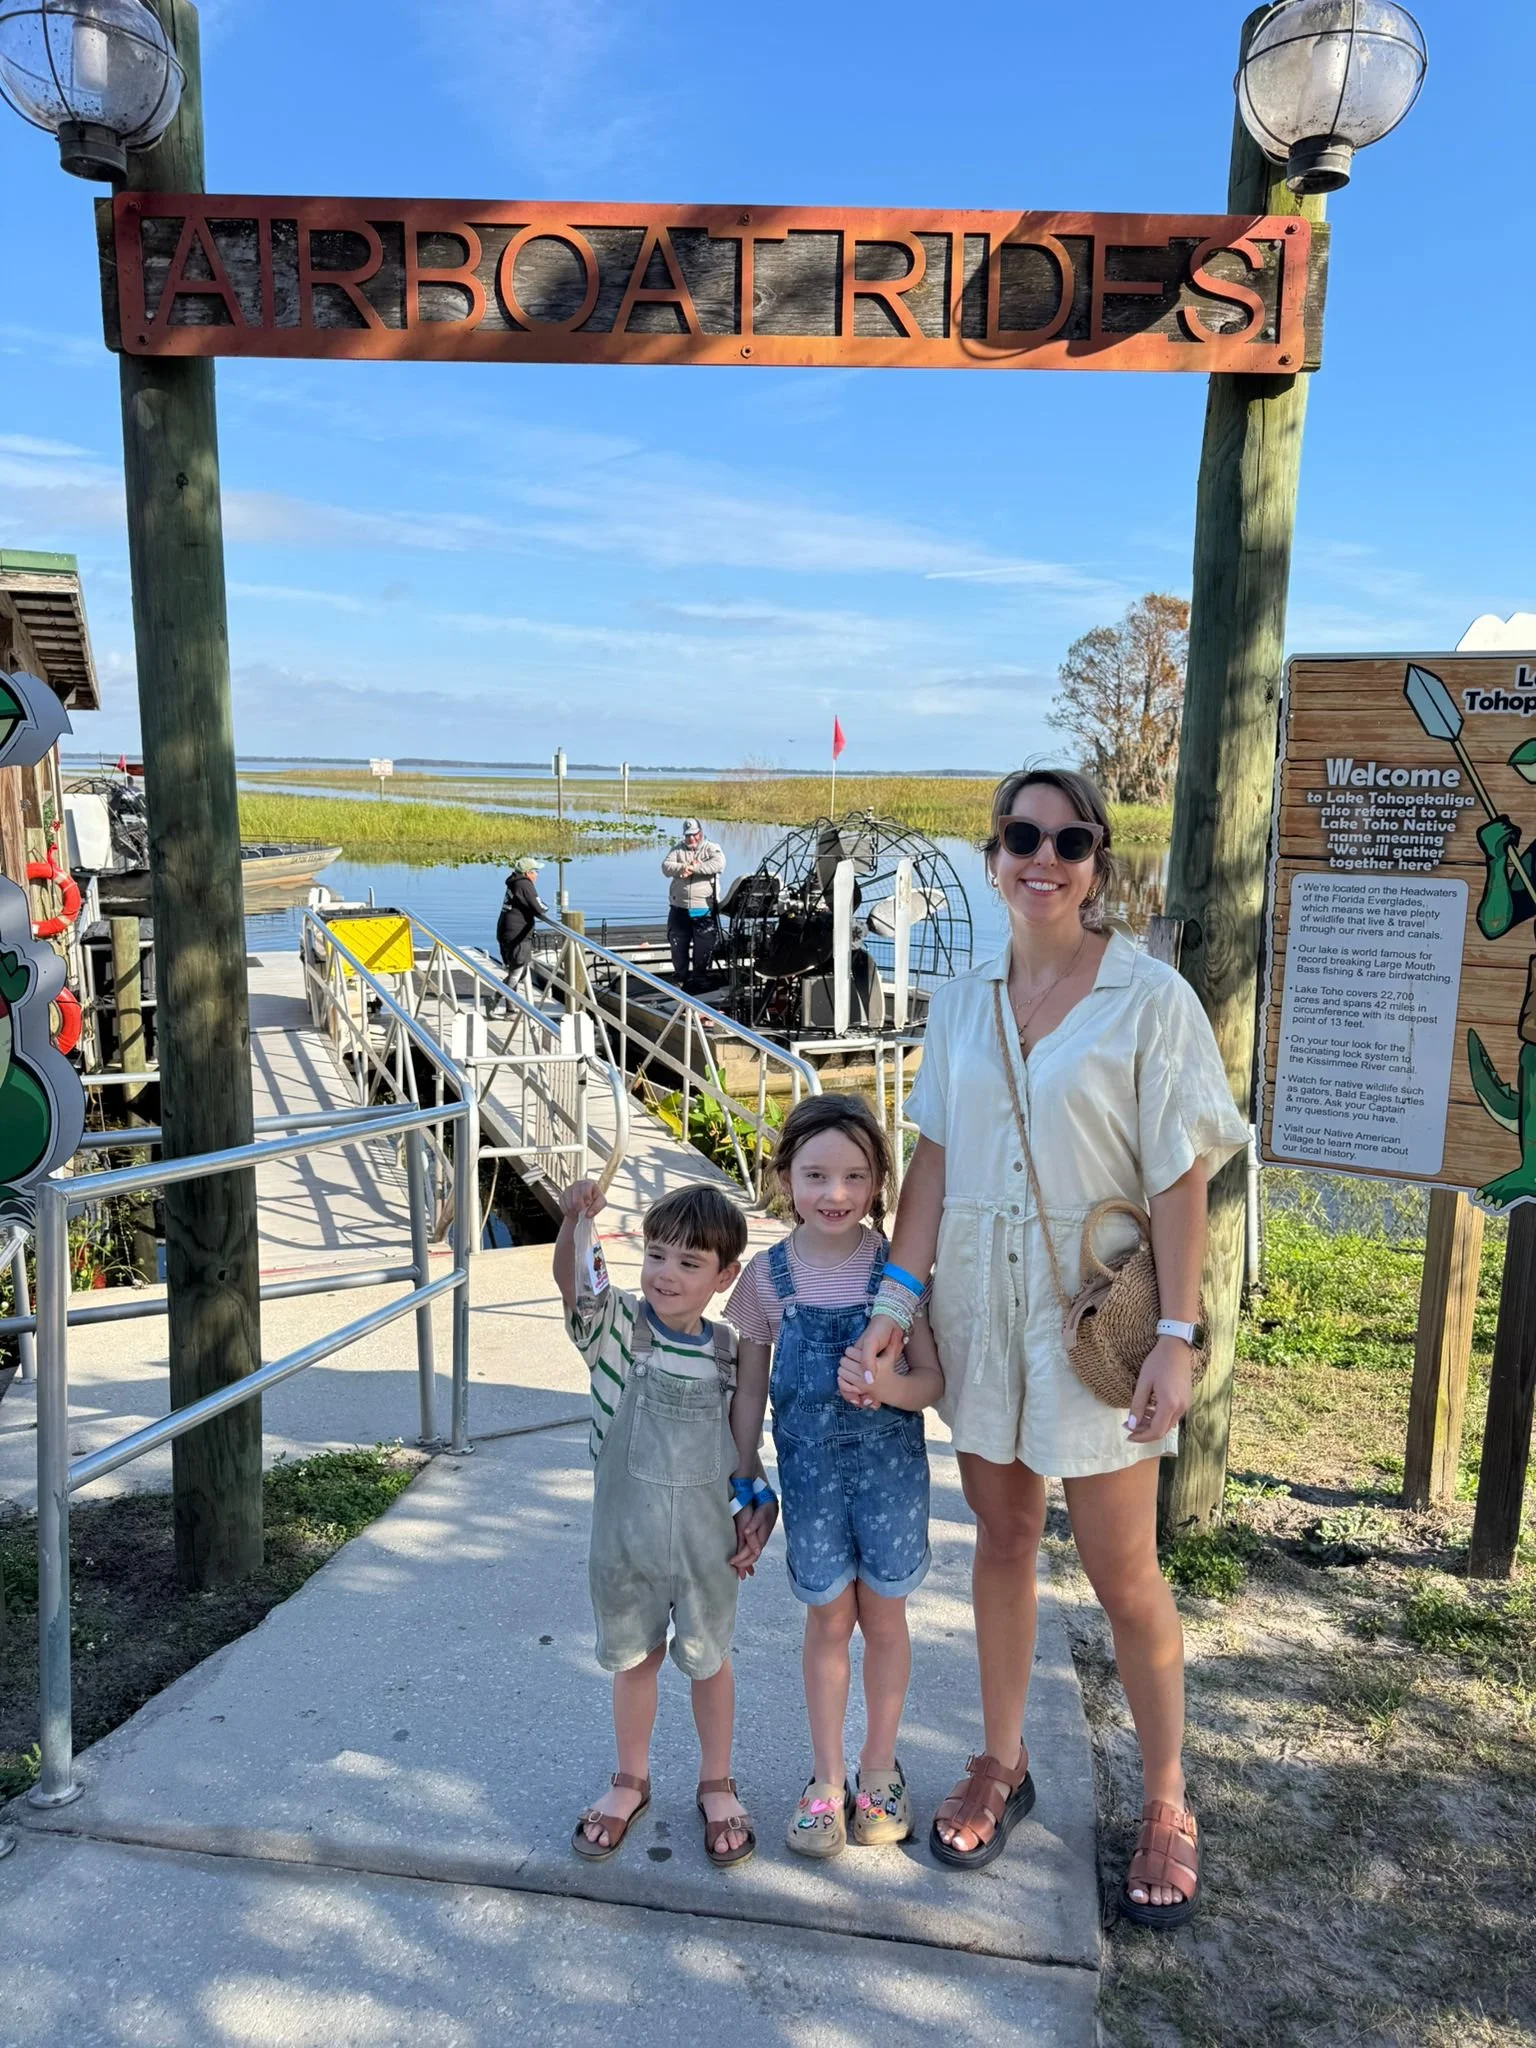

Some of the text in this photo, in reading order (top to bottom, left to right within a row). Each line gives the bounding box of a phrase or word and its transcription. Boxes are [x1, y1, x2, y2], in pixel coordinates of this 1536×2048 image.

[156, 214, 1265, 344] AIRBOAT RIDES
[1326, 757, 1460, 788] Welcome
[1306, 792, 1474, 807] to Lake Tohopekaliga
[1321, 804, 1458, 819] also referred to as
[1321, 817, 1456, 832] Lake Toho Native
[1329, 833, 1444, 847] name meaning
[1327, 842, 1445, 859] “We will gather
[1329, 857, 1439, 871] together here”
[1332, 884, 1366, 894] located
[1383, 886, 1398, 895] the
[1400, 887, 1458, 897] Headwaters
[1302, 893, 1312, 901] of
[1314, 894, 1330, 902] the
[1332, 894, 1365, 904] Florida
[1301, 904, 1329, 912] which
[1383, 907, 1408, 916] have
[1410, 908, 1441, 919] plenty
[1300, 914, 1425, 927] of wildlife that live & travel
[1300, 924, 1336, 935] through
[1357, 927, 1384, 936] rivers
[1386, 929, 1405, 937] and
[1408, 931, 1443, 939] canals.
[1298, 944, 1432, 960] Our lake is world famous for
[1297, 956, 1436, 970] record breaking Large Mouth
[1296, 964, 1320, 973] Bass
[1323, 966, 1354, 977] fishing
[1356, 968, 1364, 976] &
[1388, 970, 1453, 984] birdwatching.
[1295, 985, 1414, 1000] Lake Toho covers 22,700
[1322, 998, 1341, 1006] and
[1342, 1000, 1372, 1008] spans
[1374, 1000, 1387, 1009] 42
[1389, 1002, 1415, 1011] miles
[1418, 1004, 1427, 1012] in
[1292, 1016, 1365, 1028] point of 13 feet.
[1293, 1005, 1438, 1024] circumference with its deepest
[1291, 1035, 1305, 1043] On
[1331, 1038, 1350, 1047] tour
[1352, 1039, 1372, 1049] look
[1374, 1041, 1388, 1050] for
[1390, 1043, 1405, 1051] the
[1290, 1044, 1412, 1063] fascinating lock system to
[1289, 1054, 1417, 1074] the Kissimmee River canal.
[1288, 1074, 1424, 1095] Watch for native wildlife such
[1335, 1089, 1357, 1098] Bald
[1359, 1091, 1392, 1102] Eagles
[1286, 1094, 1406, 1114] & more. Ask your Captain
[1285, 1105, 1303, 1114] any
[1304, 1107, 1350, 1118] questions
[1372, 1113, 1398, 1123] have.
[1284, 1123, 1304, 1133] Visit
[1324, 1127, 1354, 1138] Native
[1355, 1131, 1401, 1144] American
[1283, 1133, 1409, 1155] Village to learn more about
[1300, 1144, 1322, 1155] local
[1324, 1148, 1357, 1160] history.
